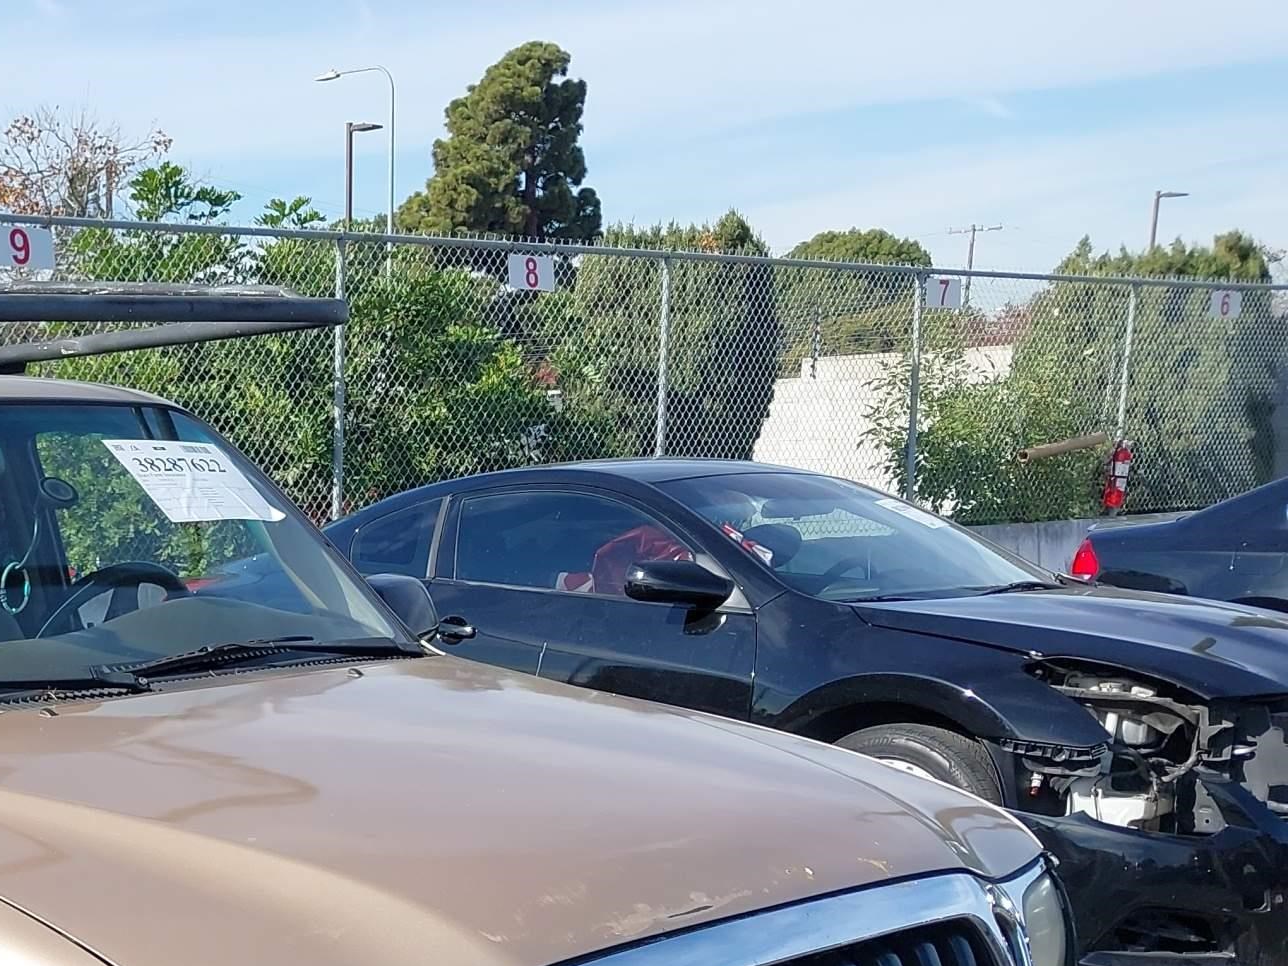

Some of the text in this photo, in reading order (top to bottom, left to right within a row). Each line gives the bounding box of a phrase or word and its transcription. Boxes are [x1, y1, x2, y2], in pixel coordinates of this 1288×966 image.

[9, 228, 30, 265] 9
[525, 257, 539, 288] 8
[939, 279, 950, 306] 7
[1221, 293, 1231, 316] 6
[132, 457, 227, 473] 38287622
